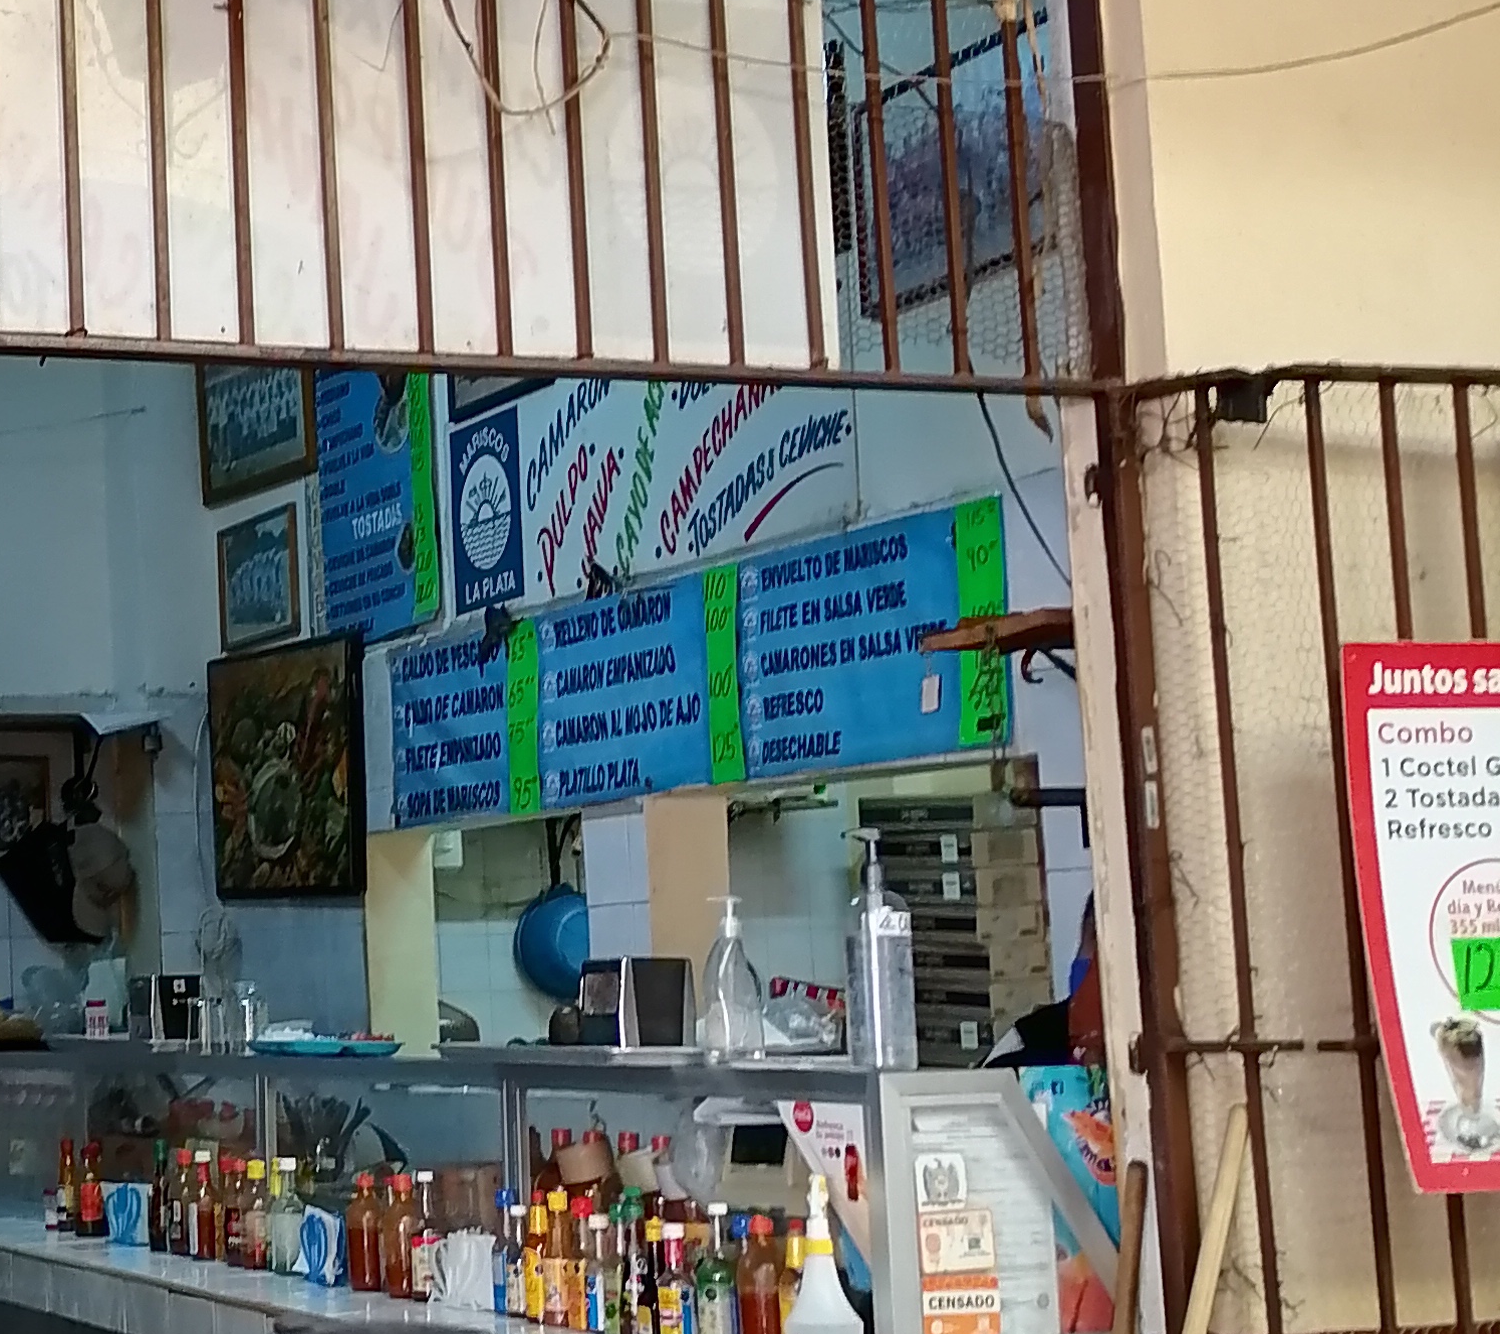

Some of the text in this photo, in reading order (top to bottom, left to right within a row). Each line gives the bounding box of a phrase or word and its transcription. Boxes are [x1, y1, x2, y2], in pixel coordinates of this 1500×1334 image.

[457, 425, 511, 478] MARISCOS
[526, 378, 611, 512] CAMARON
[687, 453, 766, 557] TOSTADAS
[778, 408, 849, 468] CEVICHE
[351, 503, 403, 540] TOSTADAS
[537, 443, 589, 598] PULPO
[761, 533, 909, 593] ENVUELTO DE MARISCOS
[465, 575, 516, 601] LA PLATA
[801, 598, 823, 626] EN
[824, 589, 863, 622] SALSA
[865, 581, 908, 615] VERDE
[600, 611, 617, 638] DE
[401, 649, 433, 683] CALDO
[434, 646, 449, 675] DE
[760, 640, 838, 678] CAMARONES
[857, 628, 902, 662] SALSA
[555, 662, 604, 699] CAMARON
[1368, 661, 1500, 695] Juntos sa
[449, 682, 504, 717] CAMARON
[762, 688, 825, 722] REFRESCO
[555, 712, 608, 749] CAMARON
[658, 698, 674, 728] DE
[675, 691, 702, 725] AJO
[1377, 721, 1474, 746] Combo
[762, 730, 843, 765] DESECHABLE
[559, 757, 640, 799] PLATILLO PLATA
[1381, 754, 1500, 778] 1 Coctel G
[406, 790, 433, 819] SOPA
[448, 779, 501, 813] MARISCOS
[1384, 785, 1500, 809] 2 Tostada
[1387, 818, 1493, 841] Refresco
[1450, 919, 1478, 935] 355
[1474, 902, 1483, 919] y
[923, 1214, 969, 1228] CENSADO
[928, 1293, 996, 1311] CENSADO
